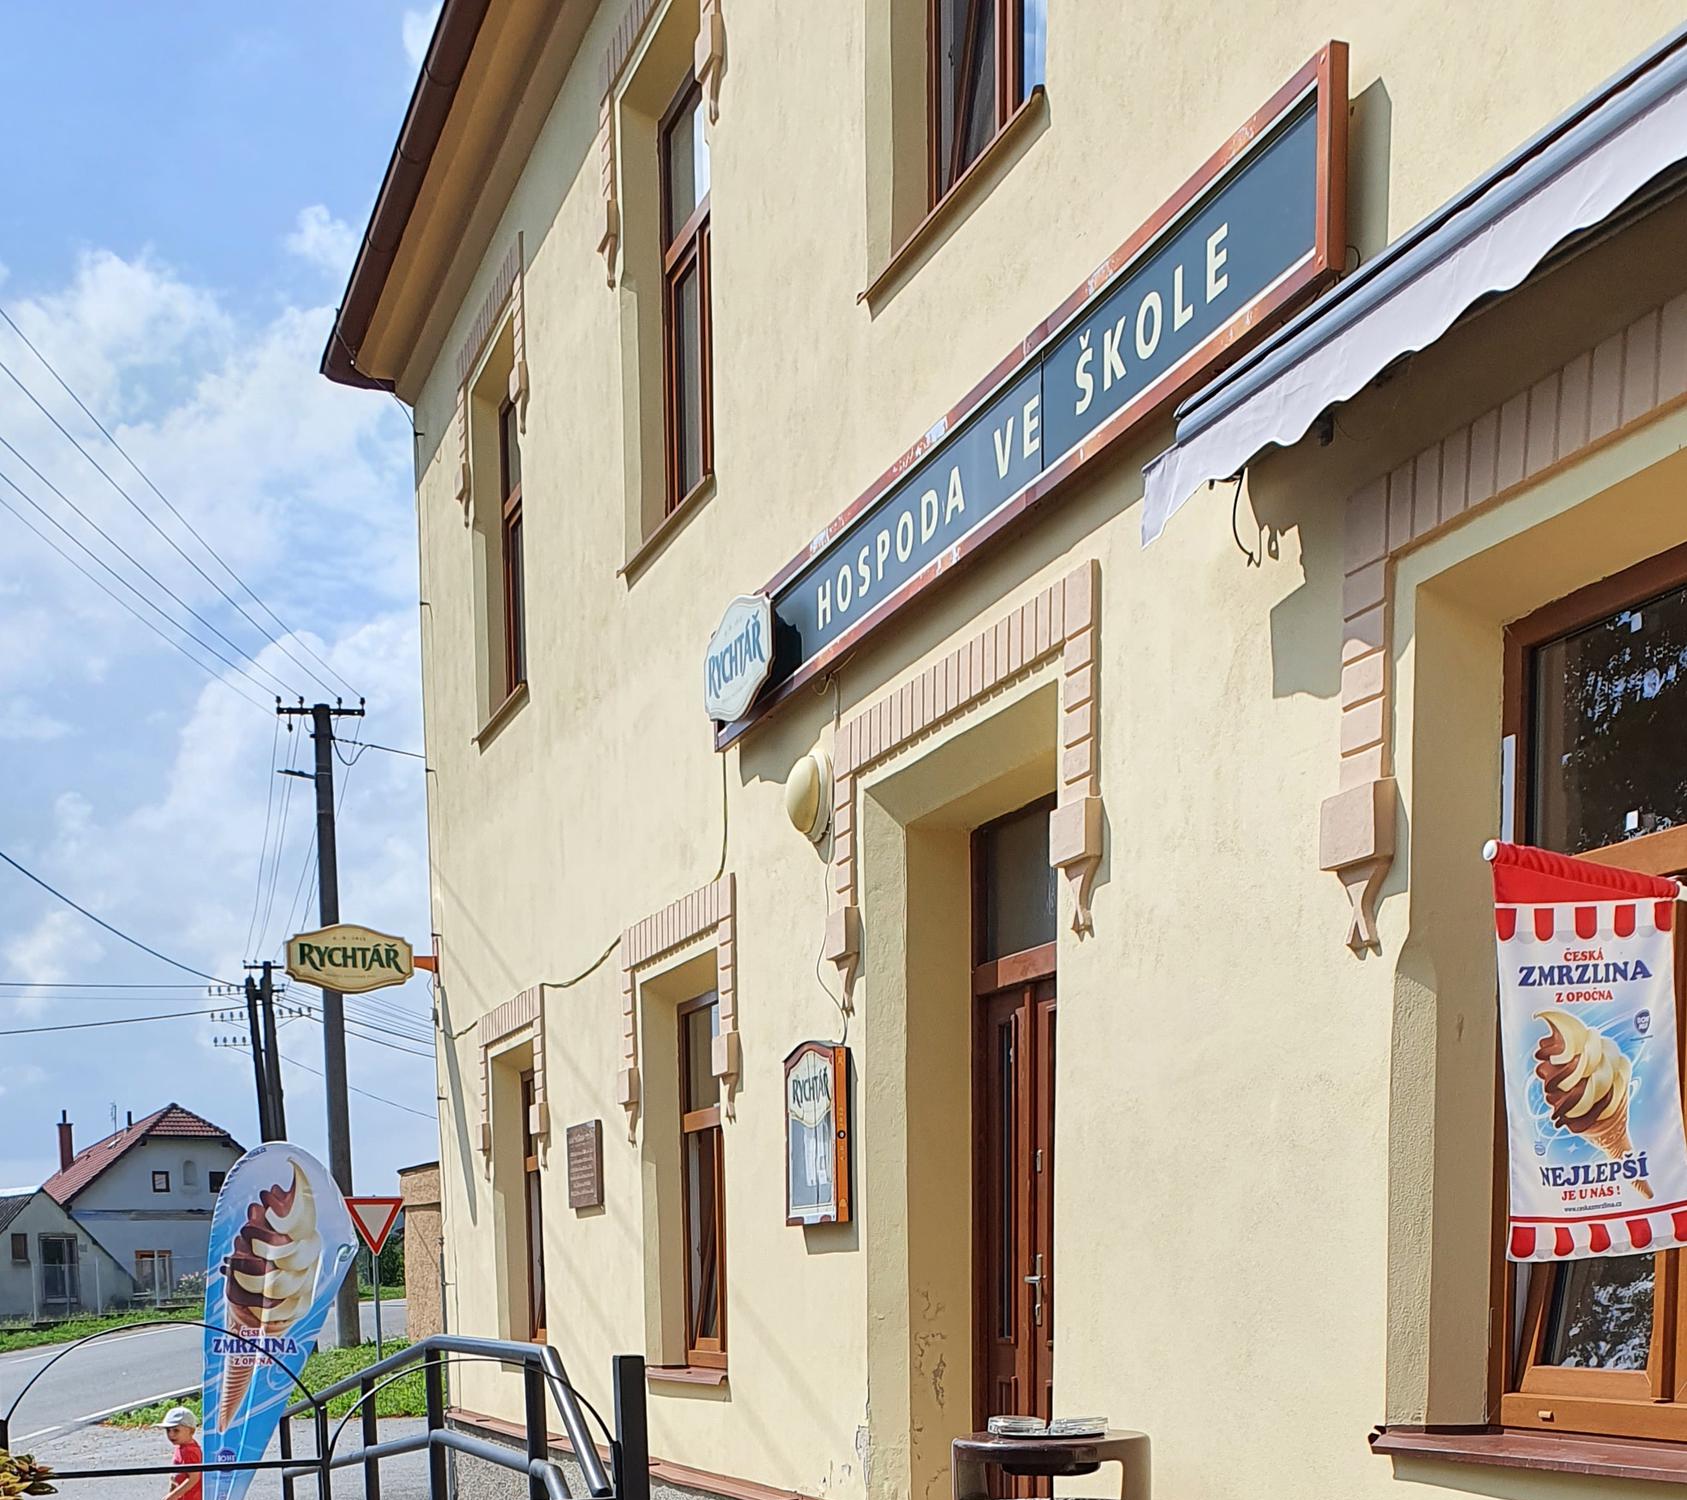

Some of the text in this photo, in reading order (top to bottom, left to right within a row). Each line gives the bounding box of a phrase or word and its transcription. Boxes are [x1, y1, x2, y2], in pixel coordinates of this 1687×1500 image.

[816, 221, 1229, 631] HOSPODA VE ŠKOLE
[708, 609, 765, 699] RYCHTÁŘ
[298, 942, 406, 974] RYCHTÁŘ
[1563, 947, 1604, 962] ČESKÁ
[1518, 959, 1653, 987] ZMRZLINA
[1555, 987, 1614, 1003] Z OPOČNA
[791, 1066, 832, 1108] RYCHTÁŘ
[1539, 1151, 1649, 1187] NEJLEPŠÍ
[1561, 1190, 1576, 1201] JE
[1579, 1189, 1588, 1200] U
[240, 1327, 266, 1337] ČES
[242, 1357, 273, 1365] OPNA
